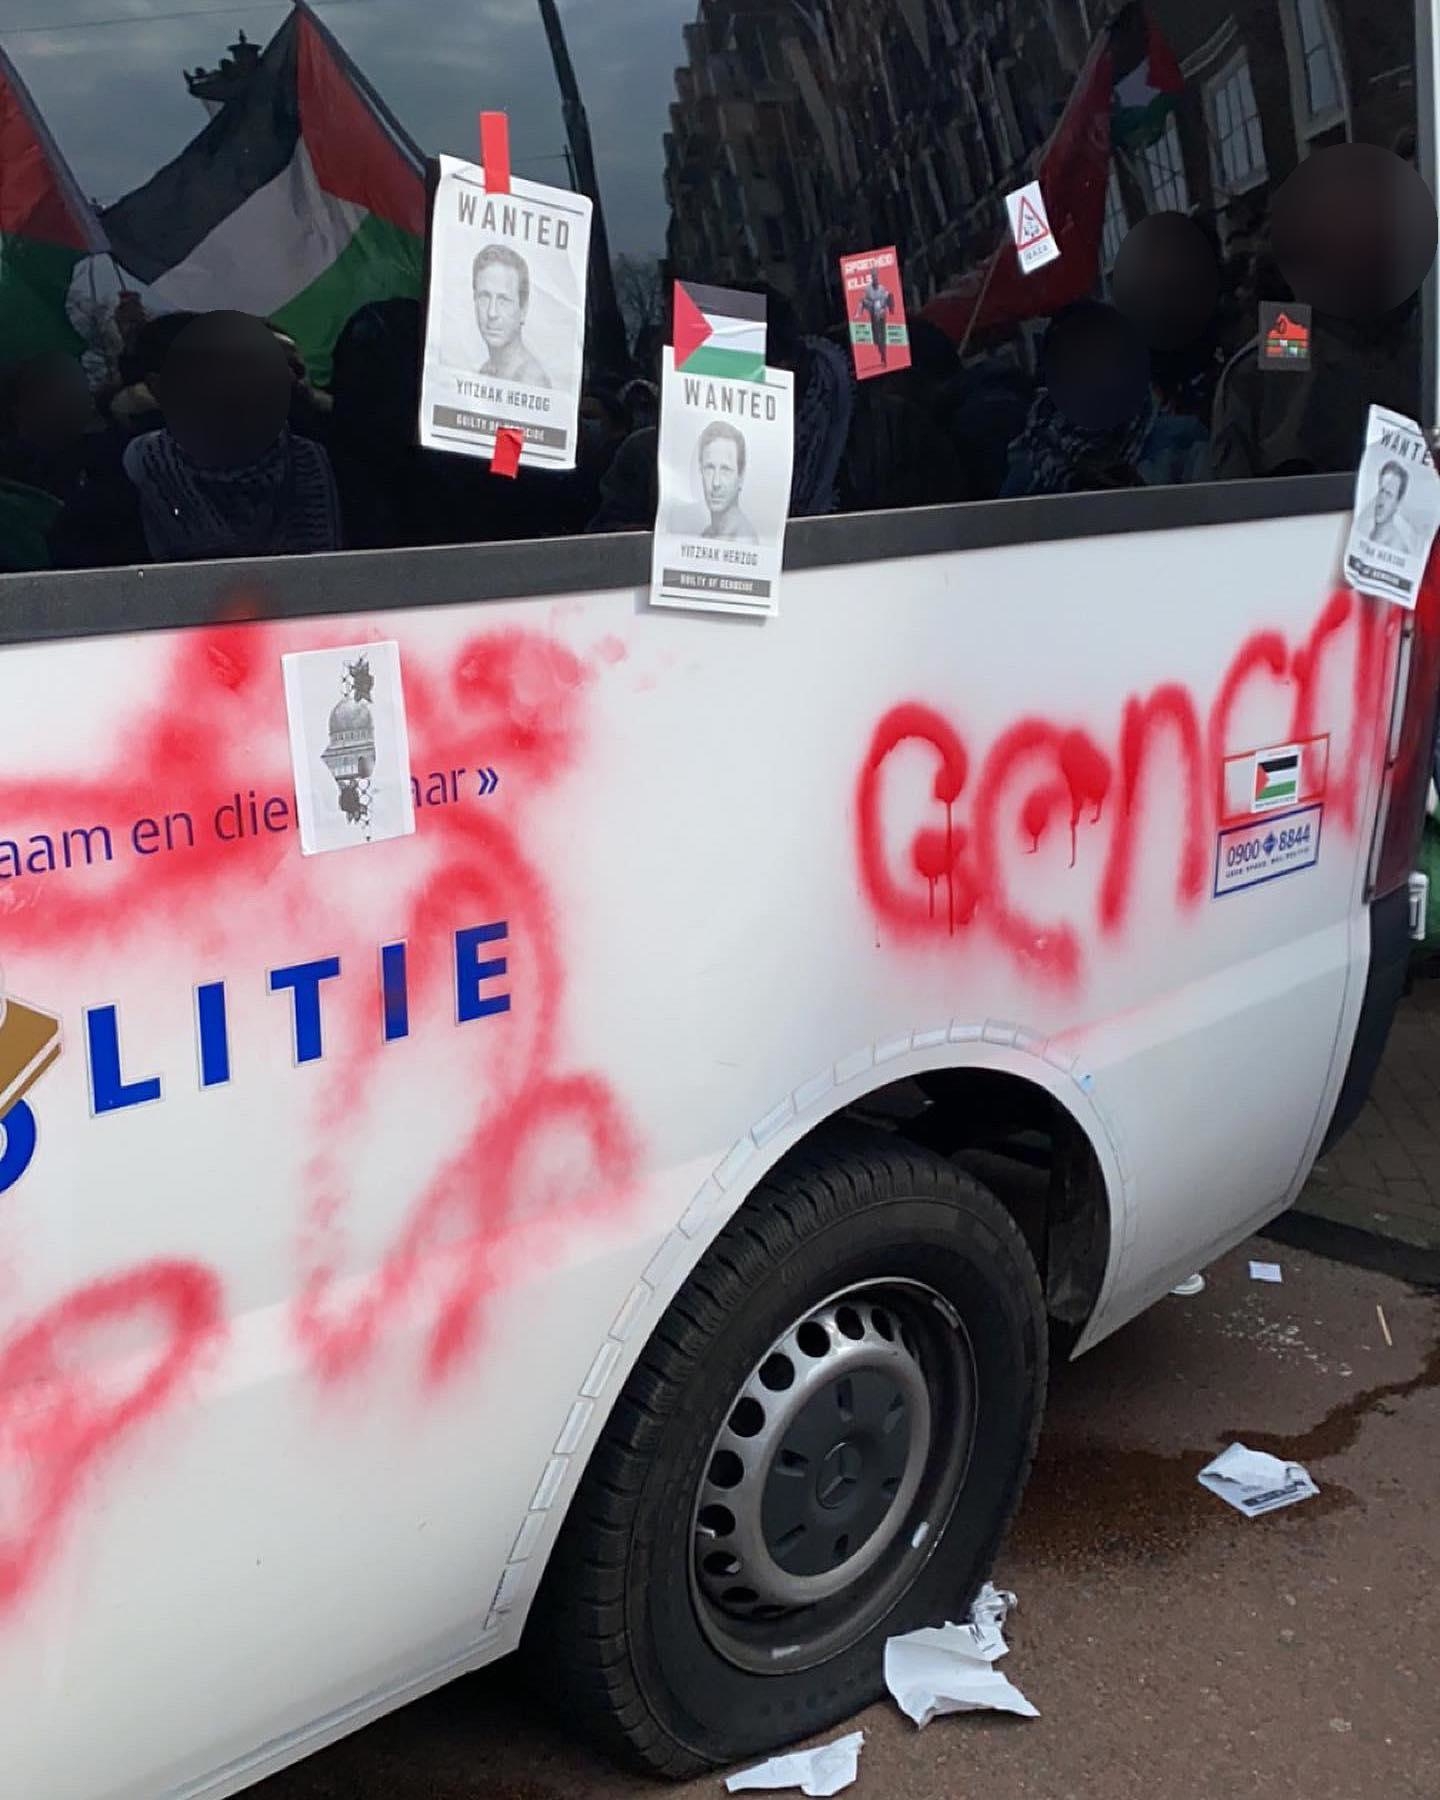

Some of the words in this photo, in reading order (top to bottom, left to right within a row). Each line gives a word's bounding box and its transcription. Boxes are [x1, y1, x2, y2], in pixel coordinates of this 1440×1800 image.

[459, 191, 569, 250] WANTED
[456, 378, 504, 403] YITZHAK
[507, 390, 551, 412] HERZOG
[684, 378, 776, 421] WANTED
[723, 549, 759, 566] HERZOG
[132, 812, 194, 855] en
[1226, 840, 1260, 868] 0900
[1278, 824, 1311, 852] 8844
[0, 921, 512, 1196] LITIE
